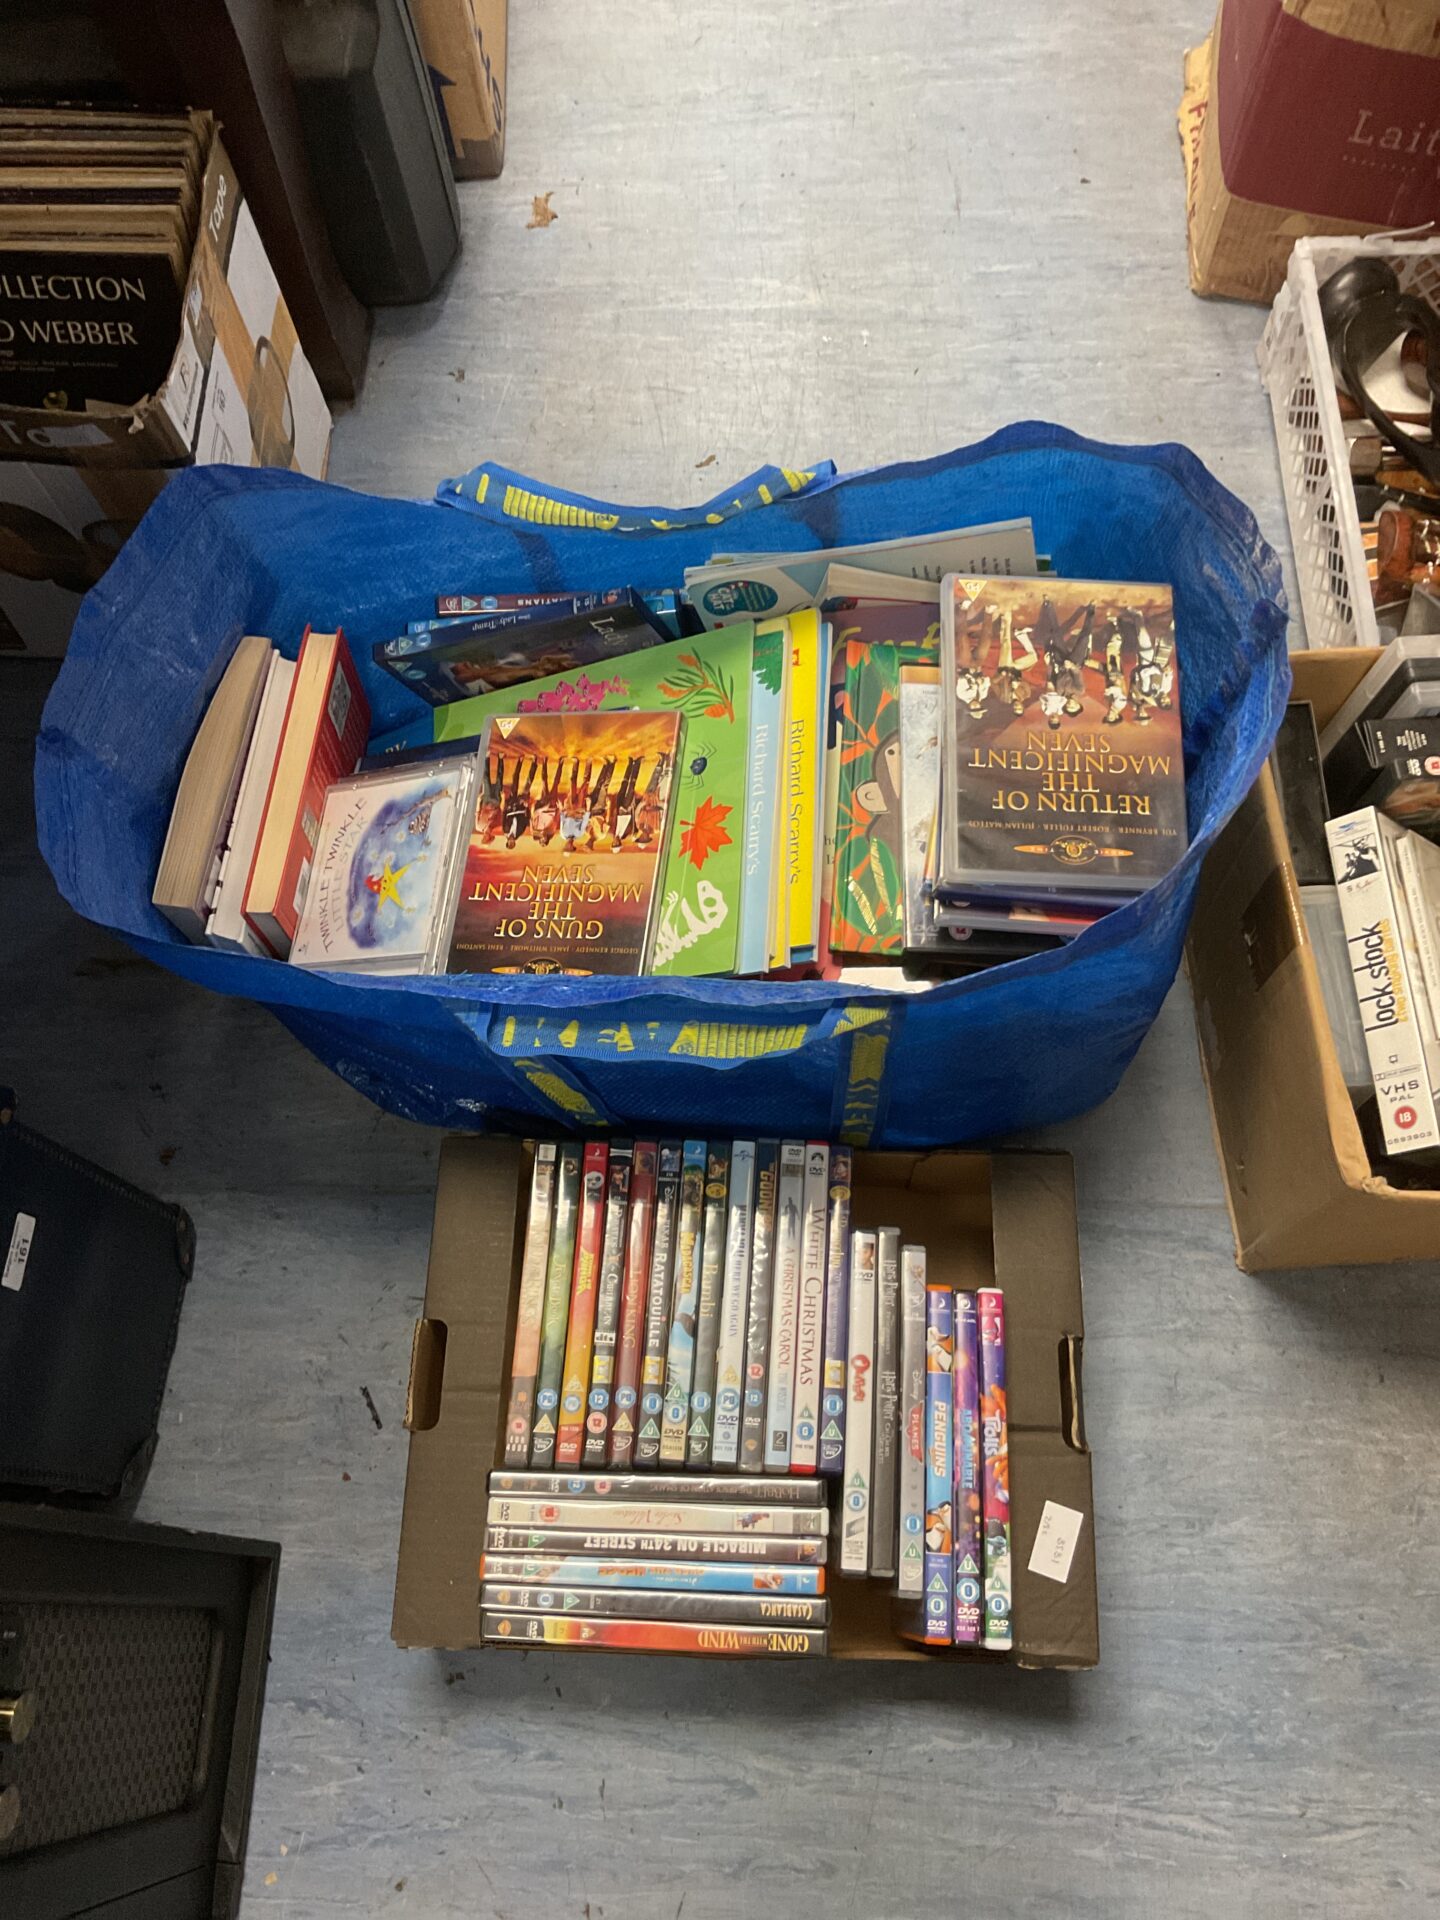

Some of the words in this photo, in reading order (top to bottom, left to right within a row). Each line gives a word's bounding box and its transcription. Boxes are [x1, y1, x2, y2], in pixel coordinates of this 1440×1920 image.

[209, 175, 226, 242] Tape
[0, 274, 146, 301] LLECTION
[20, 319, 138, 345] WEBBER
[472, 620, 496, 631] Tramp
[1026, 731, 1111, 753] SEVEN
[750, 724, 769, 797] Richard
[790, 719, 806, 798] Richard
[968, 748, 1171, 776] MAGNIFICENT
[1041, 771, 1099, 792] THE
[991, 791, 1030, 811] OF
[1036, 791, 1151, 815] RETURN
[324, 797, 367, 871] TWINKLE
[1005, 822, 1035, 830] JULIAN
[1042, 823, 1074, 831] FULLER
[1077, 824, 1109, 832] ROBERT
[1118, 826, 1158, 834] BRYNNER
[746, 800, 764, 875] Scarry's
[332, 869, 344, 932] LITTLE
[338, 816, 366, 863] STAR
[521, 865, 595, 884] SEVEN
[468, 881, 643, 902] MAGNIFICENT
[318, 878, 335, 954] TWINKLE
[528, 901, 576, 920] THE
[493, 919, 528, 938] OF
[534, 917, 604, 939] GUNS
[510, 944, 549, 952] WHITMORE
[550, 945, 570, 953] JAMES
[575, 946, 608, 954] KENNEDY
[610, 946, 638, 954] GEORGE
[1380, 1080, 1420, 1097] VHS
[1390, 1093, 1415, 1103] PAL
[1399, 1112, 1412, 1123] 18
[662, 1219, 670, 1248] PIXAR
[804, 1208, 826, 1270] WHITE
[785, 1246, 795, 1255] A
[679, 1232, 694, 1294] MADAGASCAR
[732, 1260, 741, 1283] HERE
[699, 1263, 718, 1318] Bambi
[732, 1285, 741, 1295] WE
[782, 1258, 796, 1327] CHRISTMAS
[883, 1282, 898, 1306] Potter
[648, 1252, 667, 1348] RATATOUILLE
[729, 1296, 738, 1311] GO
[622, 1310, 638, 1348] KING
[729, 1313, 737, 1337] AGAIN
[800, 1277, 822, 1385] CHRISTMAS
[778, 1329, 791, 1370] CAROL
[751, 1366, 760, 1375] 12
[911, 1369, 922, 1400] Disney
[594, 1394, 603, 1403] 12
[750, 1394, 758, 1402] 12
[881, 1394, 896, 1421] Potter
[592, 1418, 602, 1426] 12
[647, 1427, 654, 1435] U
[776, 1433, 784, 1444] 2
[910, 1413, 920, 1451] PLANES
[932, 1401, 948, 1477] PENGUINS
[984, 1410, 1001, 1456] Trolls
[960, 1408, 975, 1489] ABOMINABLE
[649, 1483, 678, 1492] SMAUG
[754, 1485, 800, 1499] HOBBIT
[584, 1536, 636, 1551] STREET
[641, 1537, 672, 1551] 34TH
[676, 1540, 697, 1552] ON
[702, 1541, 767, 1555] MIRACLE
[965, 1560, 971, 1571] U
[760, 1602, 813, 1620] CASABLANCA
[958, 1607, 979, 1616] DVD
[927, 1620, 947, 1628] DVD
[989, 1619, 1009, 1627] DVD
[581, 1628, 589, 1638] PG
[698, 1631, 740, 1649] WIND
[739, 1636, 750, 1645] THE
[752, 1638, 767, 1646] WITH
[767, 1633, 809, 1653] GONE
